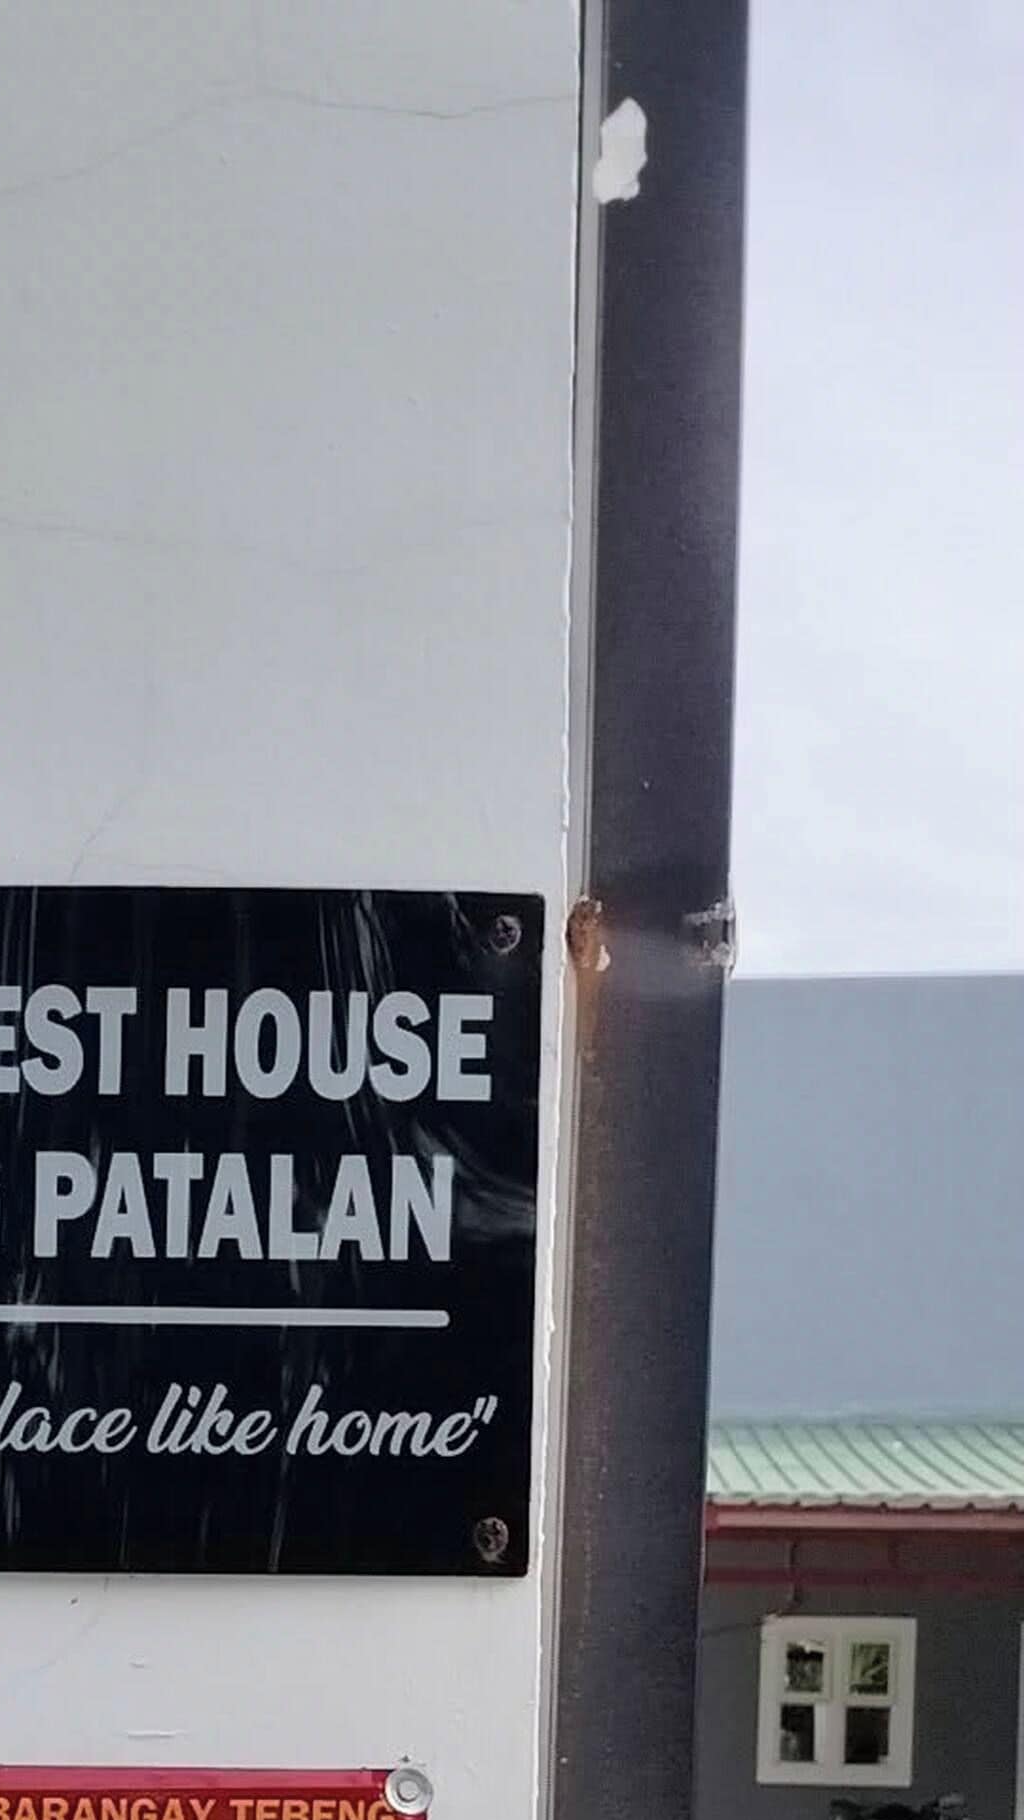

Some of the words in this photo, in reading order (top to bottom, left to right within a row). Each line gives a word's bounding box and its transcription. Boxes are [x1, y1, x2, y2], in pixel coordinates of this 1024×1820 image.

[164, 988, 494, 1102] HOUSE
[33, 1150, 454, 1262] PATALAN
[144, 1382, 278, 1459] like
[286, 1384, 498, 1460] home"
